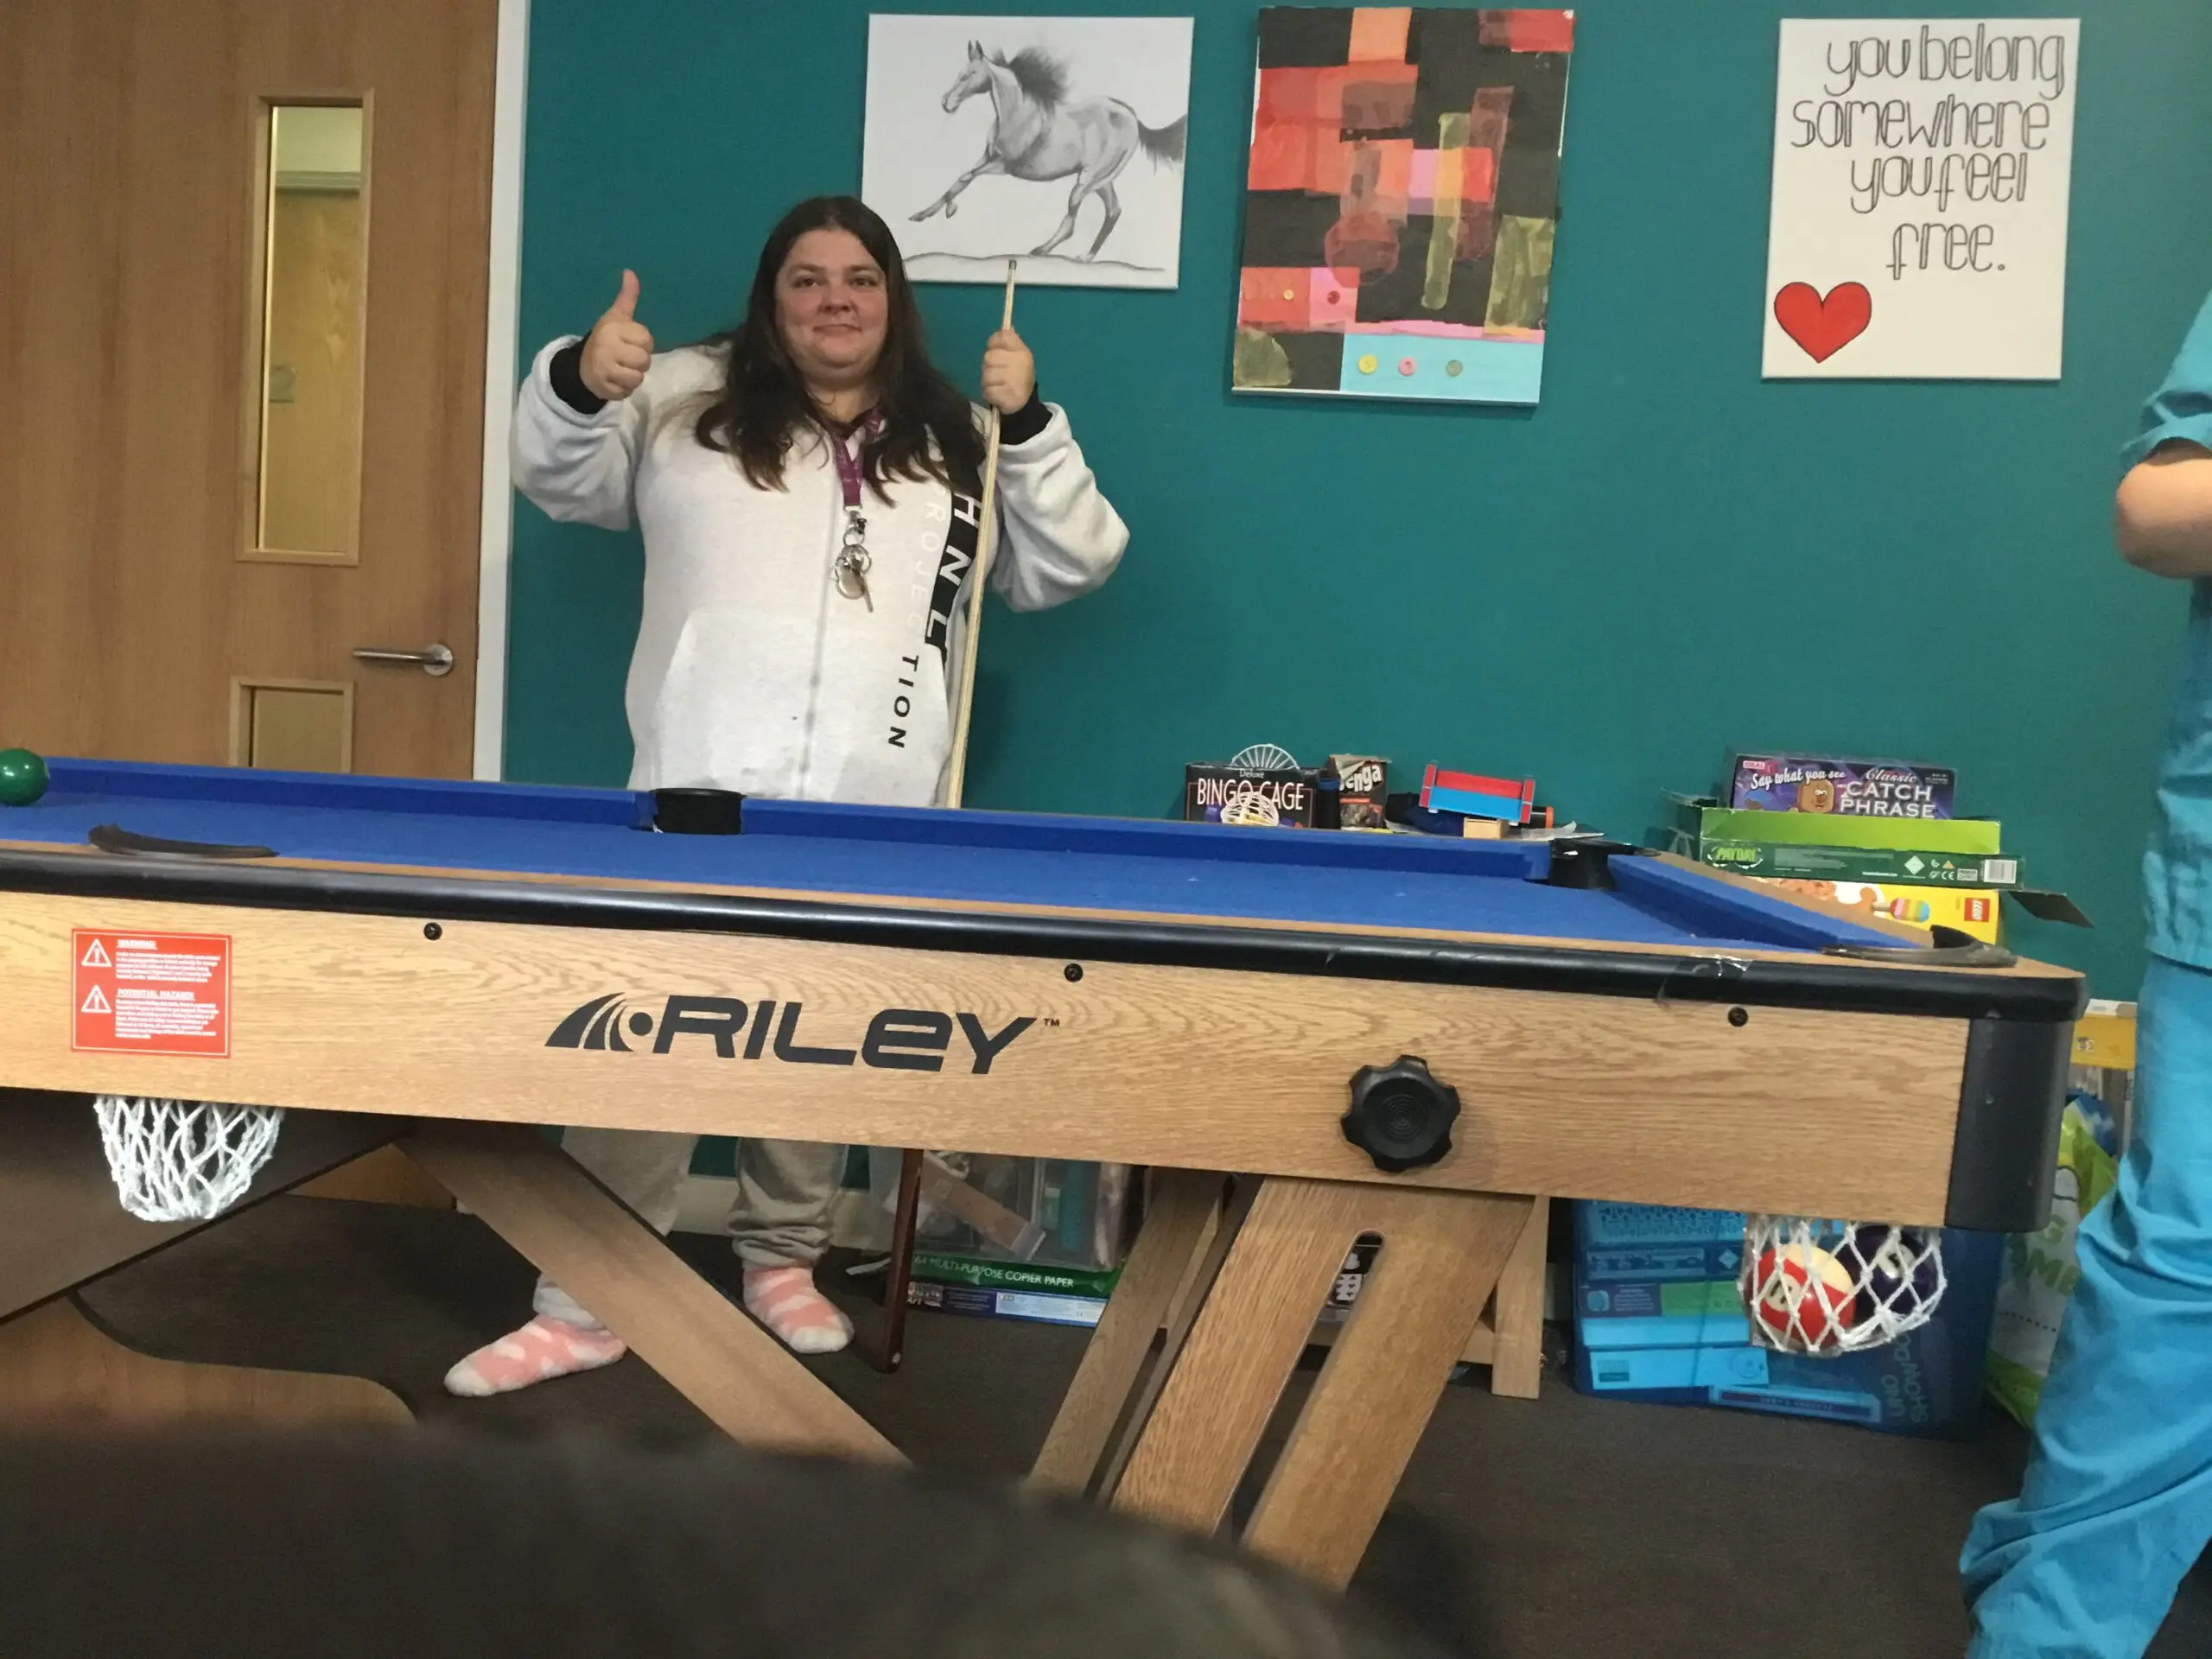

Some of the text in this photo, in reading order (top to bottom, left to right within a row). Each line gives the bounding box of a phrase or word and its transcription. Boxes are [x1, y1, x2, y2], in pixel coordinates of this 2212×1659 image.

[1824, 22, 2066, 101] you belong
[1790, 93, 2050, 150] somewhere
[1850, 152, 2029, 214] you feel
[1885, 223, 2006, 281] free.
[1239, 768, 1265, 779] Deluxe
[1751, 767, 1846, 791] Say what you see
[1865, 767, 1917, 783] Classic
[1197, 779, 1253, 807] BINGO
[1259, 781, 1305, 810] CAGE
[1846, 782, 1934, 802] CATCH
[1840, 798, 1936, 819] PHRASE
[1005, 1270, 1042, 1284] COPIER
[1044, 1275, 1074, 1287] PAPER
